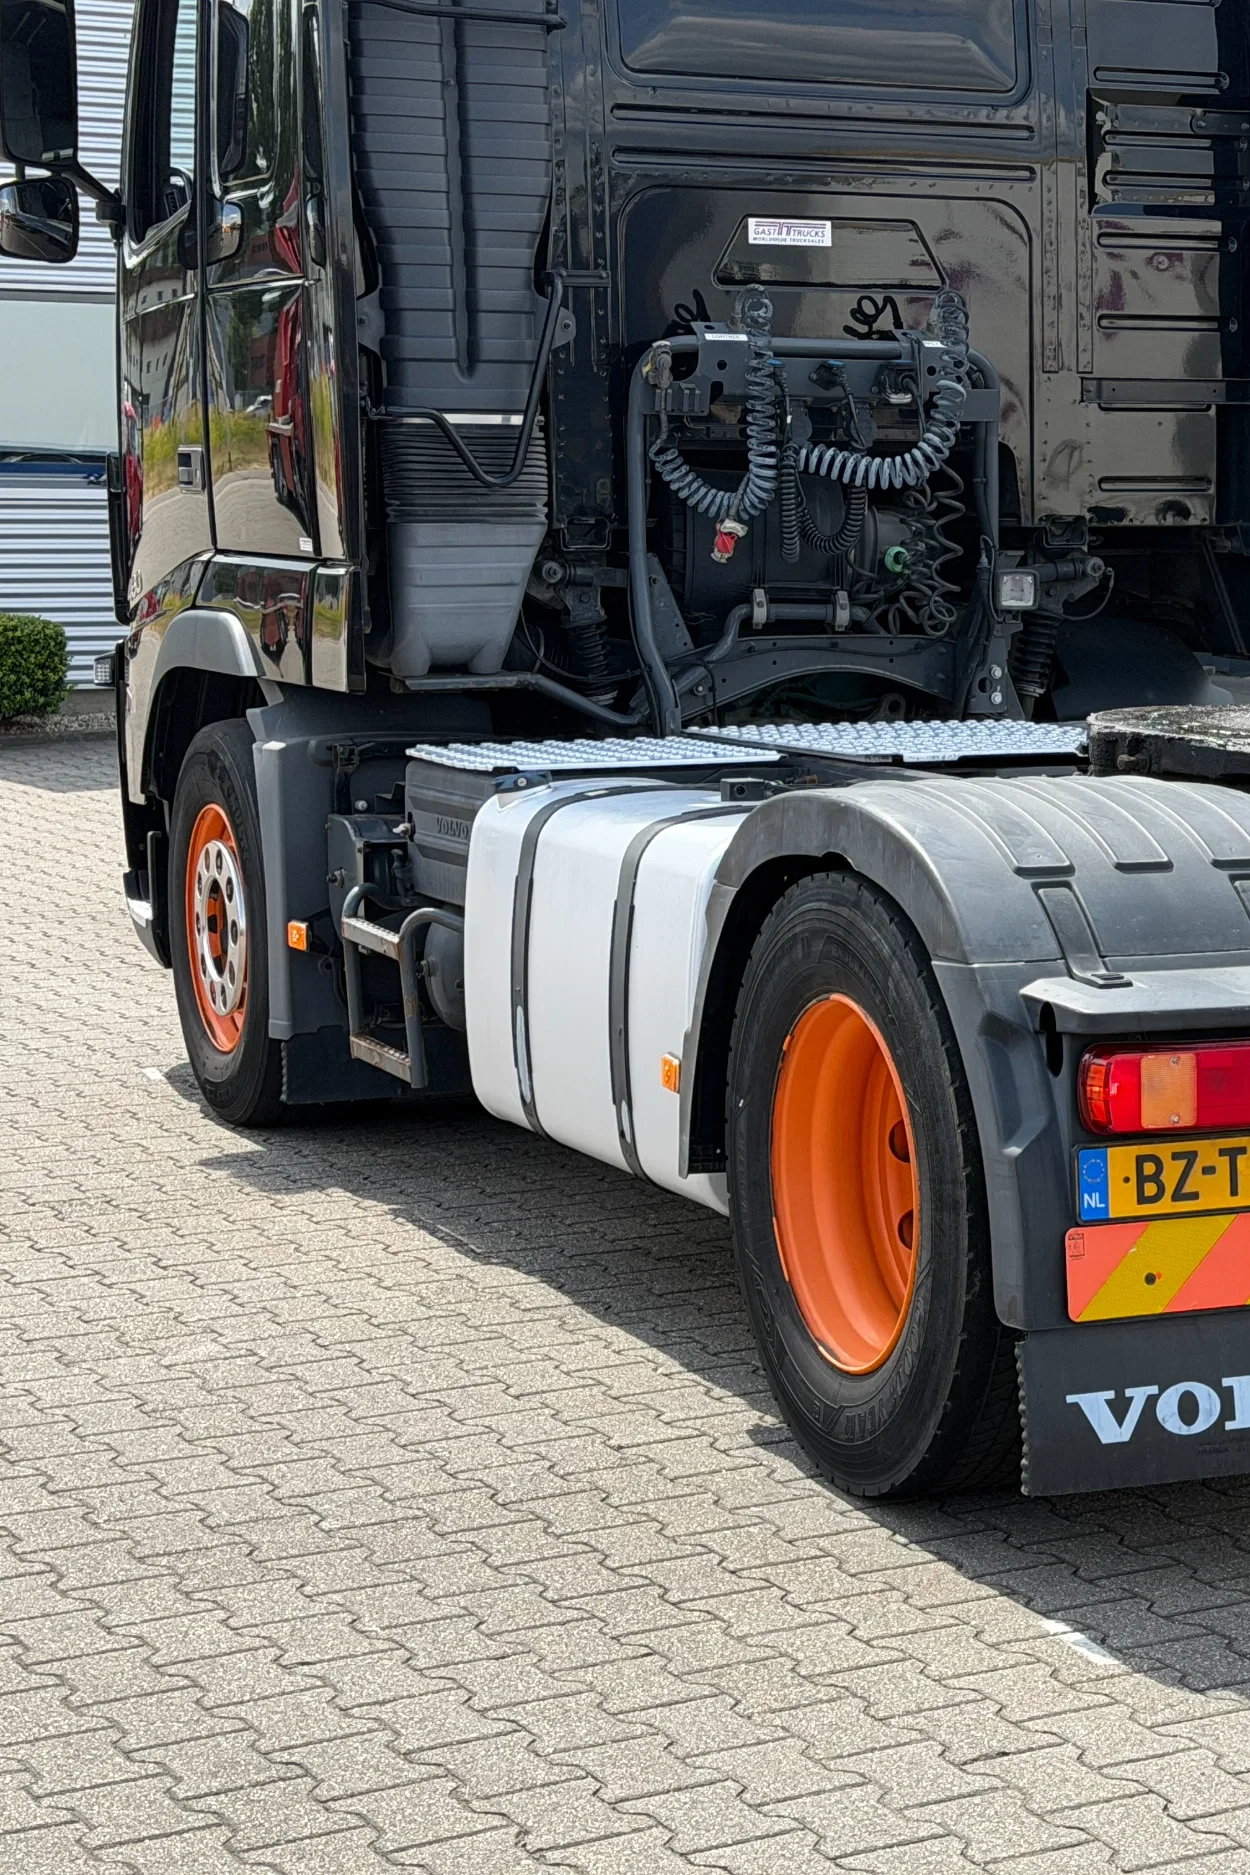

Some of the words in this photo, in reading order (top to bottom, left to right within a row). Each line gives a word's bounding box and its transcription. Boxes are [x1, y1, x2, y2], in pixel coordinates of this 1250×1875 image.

[754, 228, 777, 236] GAST
[792, 229, 826, 238] TRUCKS
[437, 816, 470, 840] VOLVO
[1083, 1192, 1106, 1209] NL
